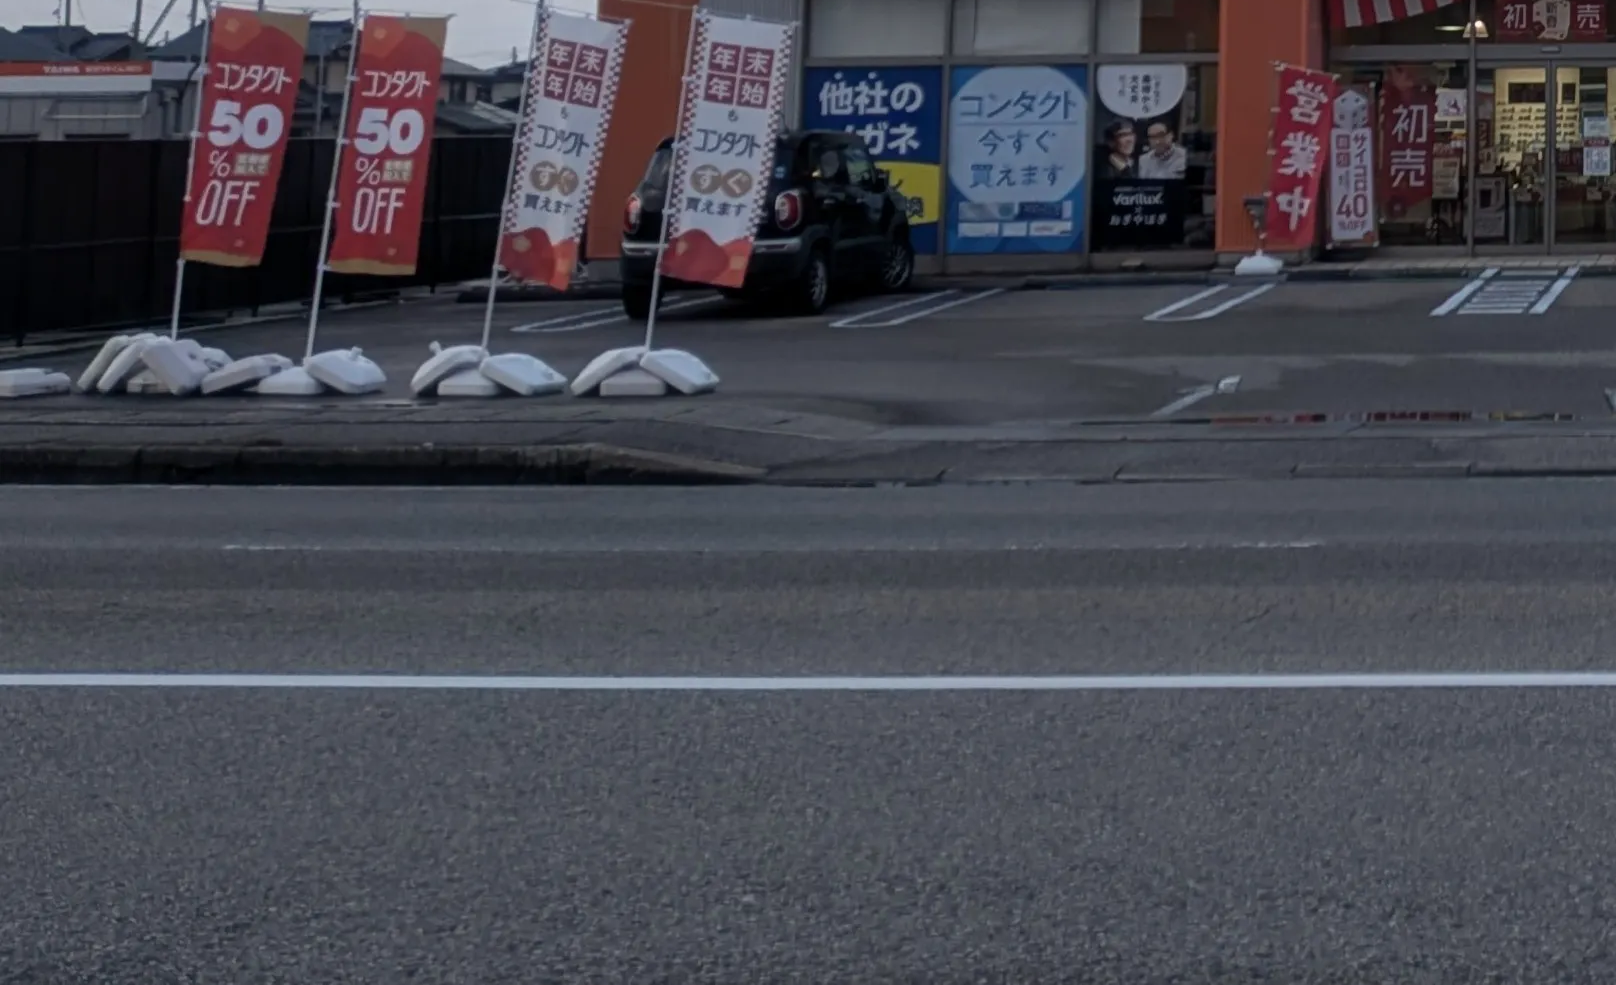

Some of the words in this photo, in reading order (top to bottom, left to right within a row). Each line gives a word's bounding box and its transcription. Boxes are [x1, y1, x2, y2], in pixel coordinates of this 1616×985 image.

[214, 62, 292, 94] コンタクト
[361, 70, 432, 98] コンタクト
[818, 79, 925, 116] 他社の
[958, 87, 1078, 120] コンタクト
[207, 99, 284, 149] 50
[353, 107, 425, 155] 50
[844, 121, 921, 156] ガネ
[693, 127, 761, 159] コンタクト
[977, 128, 1057, 155] 今すぐ
[1275, 78, 1330, 233] 営業中
[1390, 104, 1429, 188] 初売
[968, 162, 1065, 190] 買えます
[1352, 132, 1369, 192] サイコロ
[691, 165, 751, 196] すぐ
[195, 180, 260, 226] OFF
[352, 187, 406, 235] OFF
[685, 196, 748, 217] 買えます
[1336, 193, 1369, 218] 40
